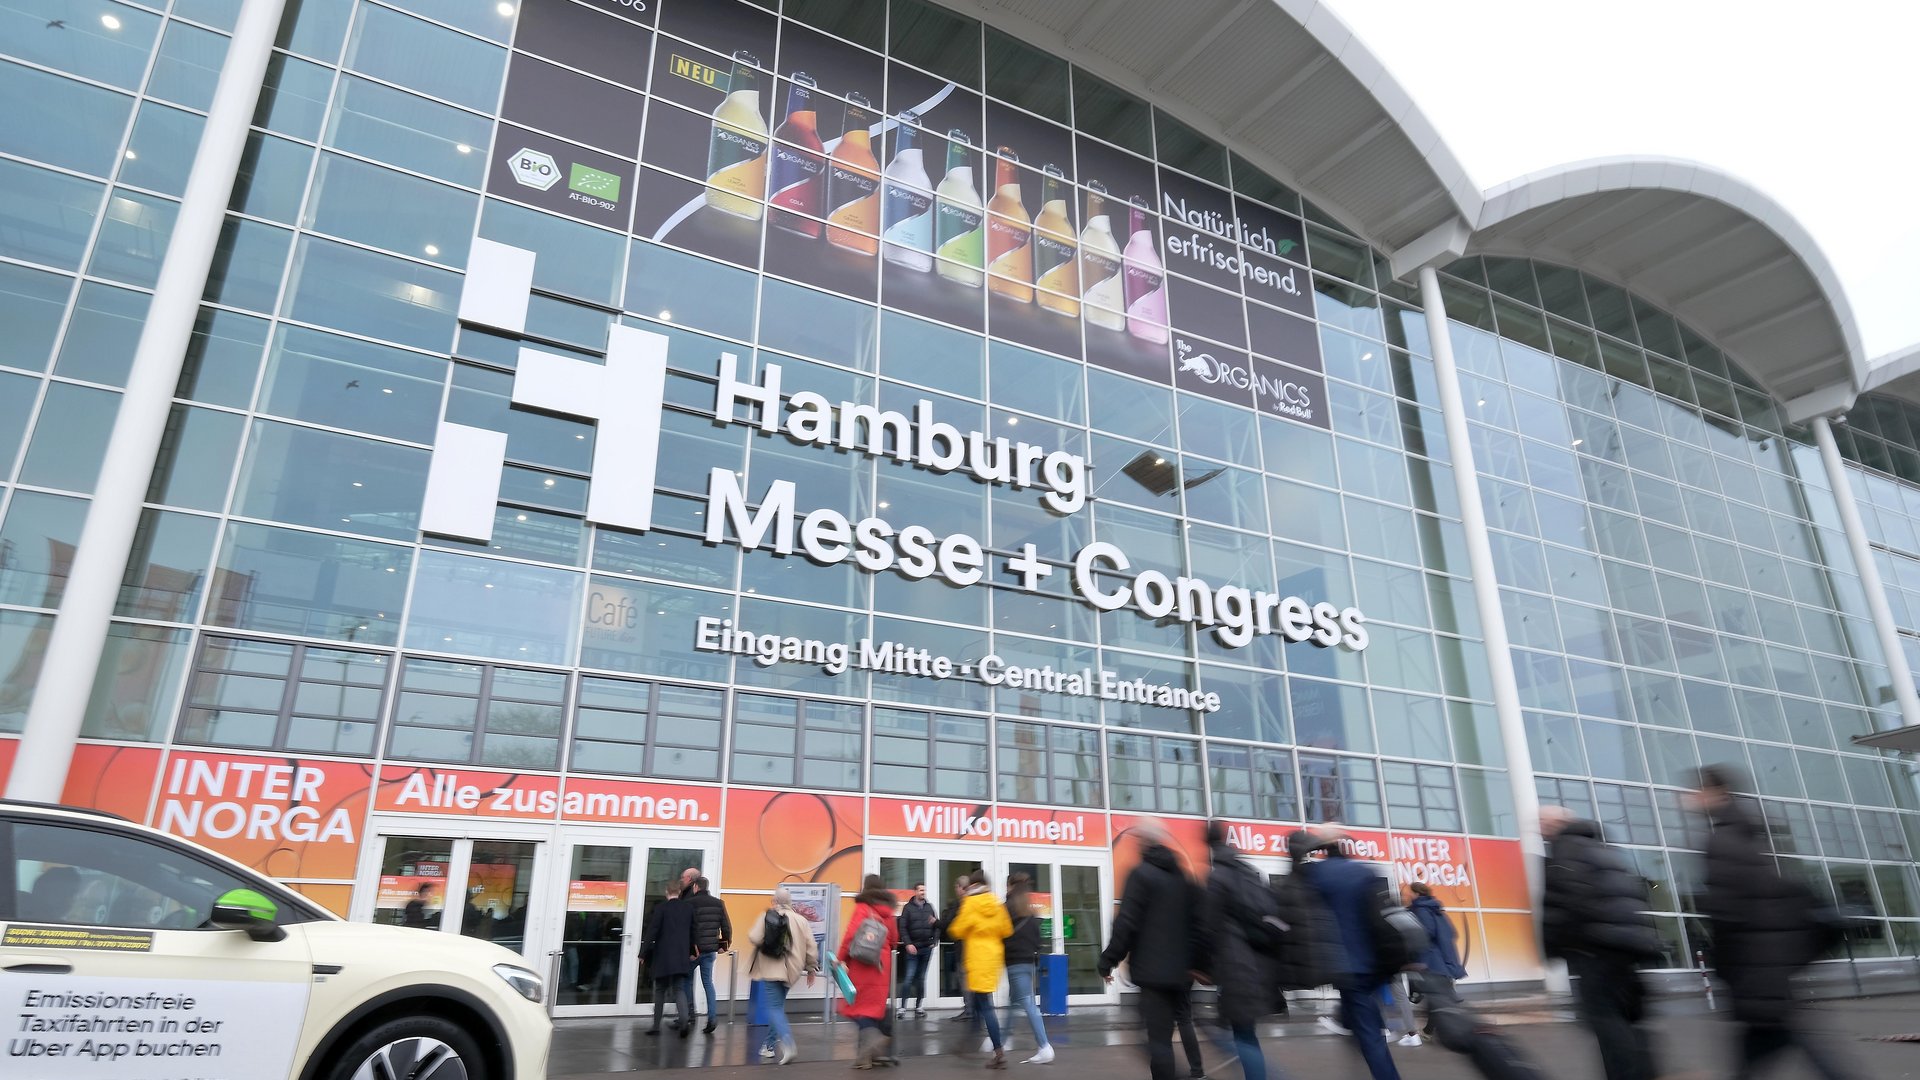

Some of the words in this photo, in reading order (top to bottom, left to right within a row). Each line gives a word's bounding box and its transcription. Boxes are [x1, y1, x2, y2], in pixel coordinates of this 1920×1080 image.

[677, 58, 715, 85] NEU
[795, 90, 810, 99] COLA
[569, 192, 615, 211] AT-BIO-902
[1164, 192, 1277, 255] Natürlich
[1167, 233, 1302, 297] erfrischend.
[1176, 338, 1192, 353] The
[1198, 353, 1311, 408] ORGANICS
[715, 351, 1085, 515] Hamburg
[705, 466, 984, 587] Messe
[1008, 542, 1053, 592] +
[1075, 541, 1370, 652] Congress
[588, 592, 638, 629] Café
[696, 615, 849, 674] Eingang
[859, 638, 952, 679] Mitte
[978, 654, 1092, 696] Central
[1100, 670, 1221, 713] Entrance
[167, 757, 327, 802] INTER
[394, 772, 481, 810] Alle
[490, 786, 711, 822] zusammen.
[158, 799, 355, 844] NORGA
[901, 803, 1086, 843] Willkommen!
[1225, 825, 1267, 852] Alle
[1269, 834, 1385, 858] zumen.
[1391, 836, 1452, 863] INTER
[1397, 861, 1471, 888] NORGA
[24, 989, 197, 1011] Emissionsfreie
[18, 1013, 155, 1033] Taxifahrten
[159, 1016, 179, 1033] in
[184, 1017, 224, 1034] der
[8, 1038, 73, 1057] Uber
[74, 1038, 131, 1062] App
[135, 1039, 222, 1057] buchen
